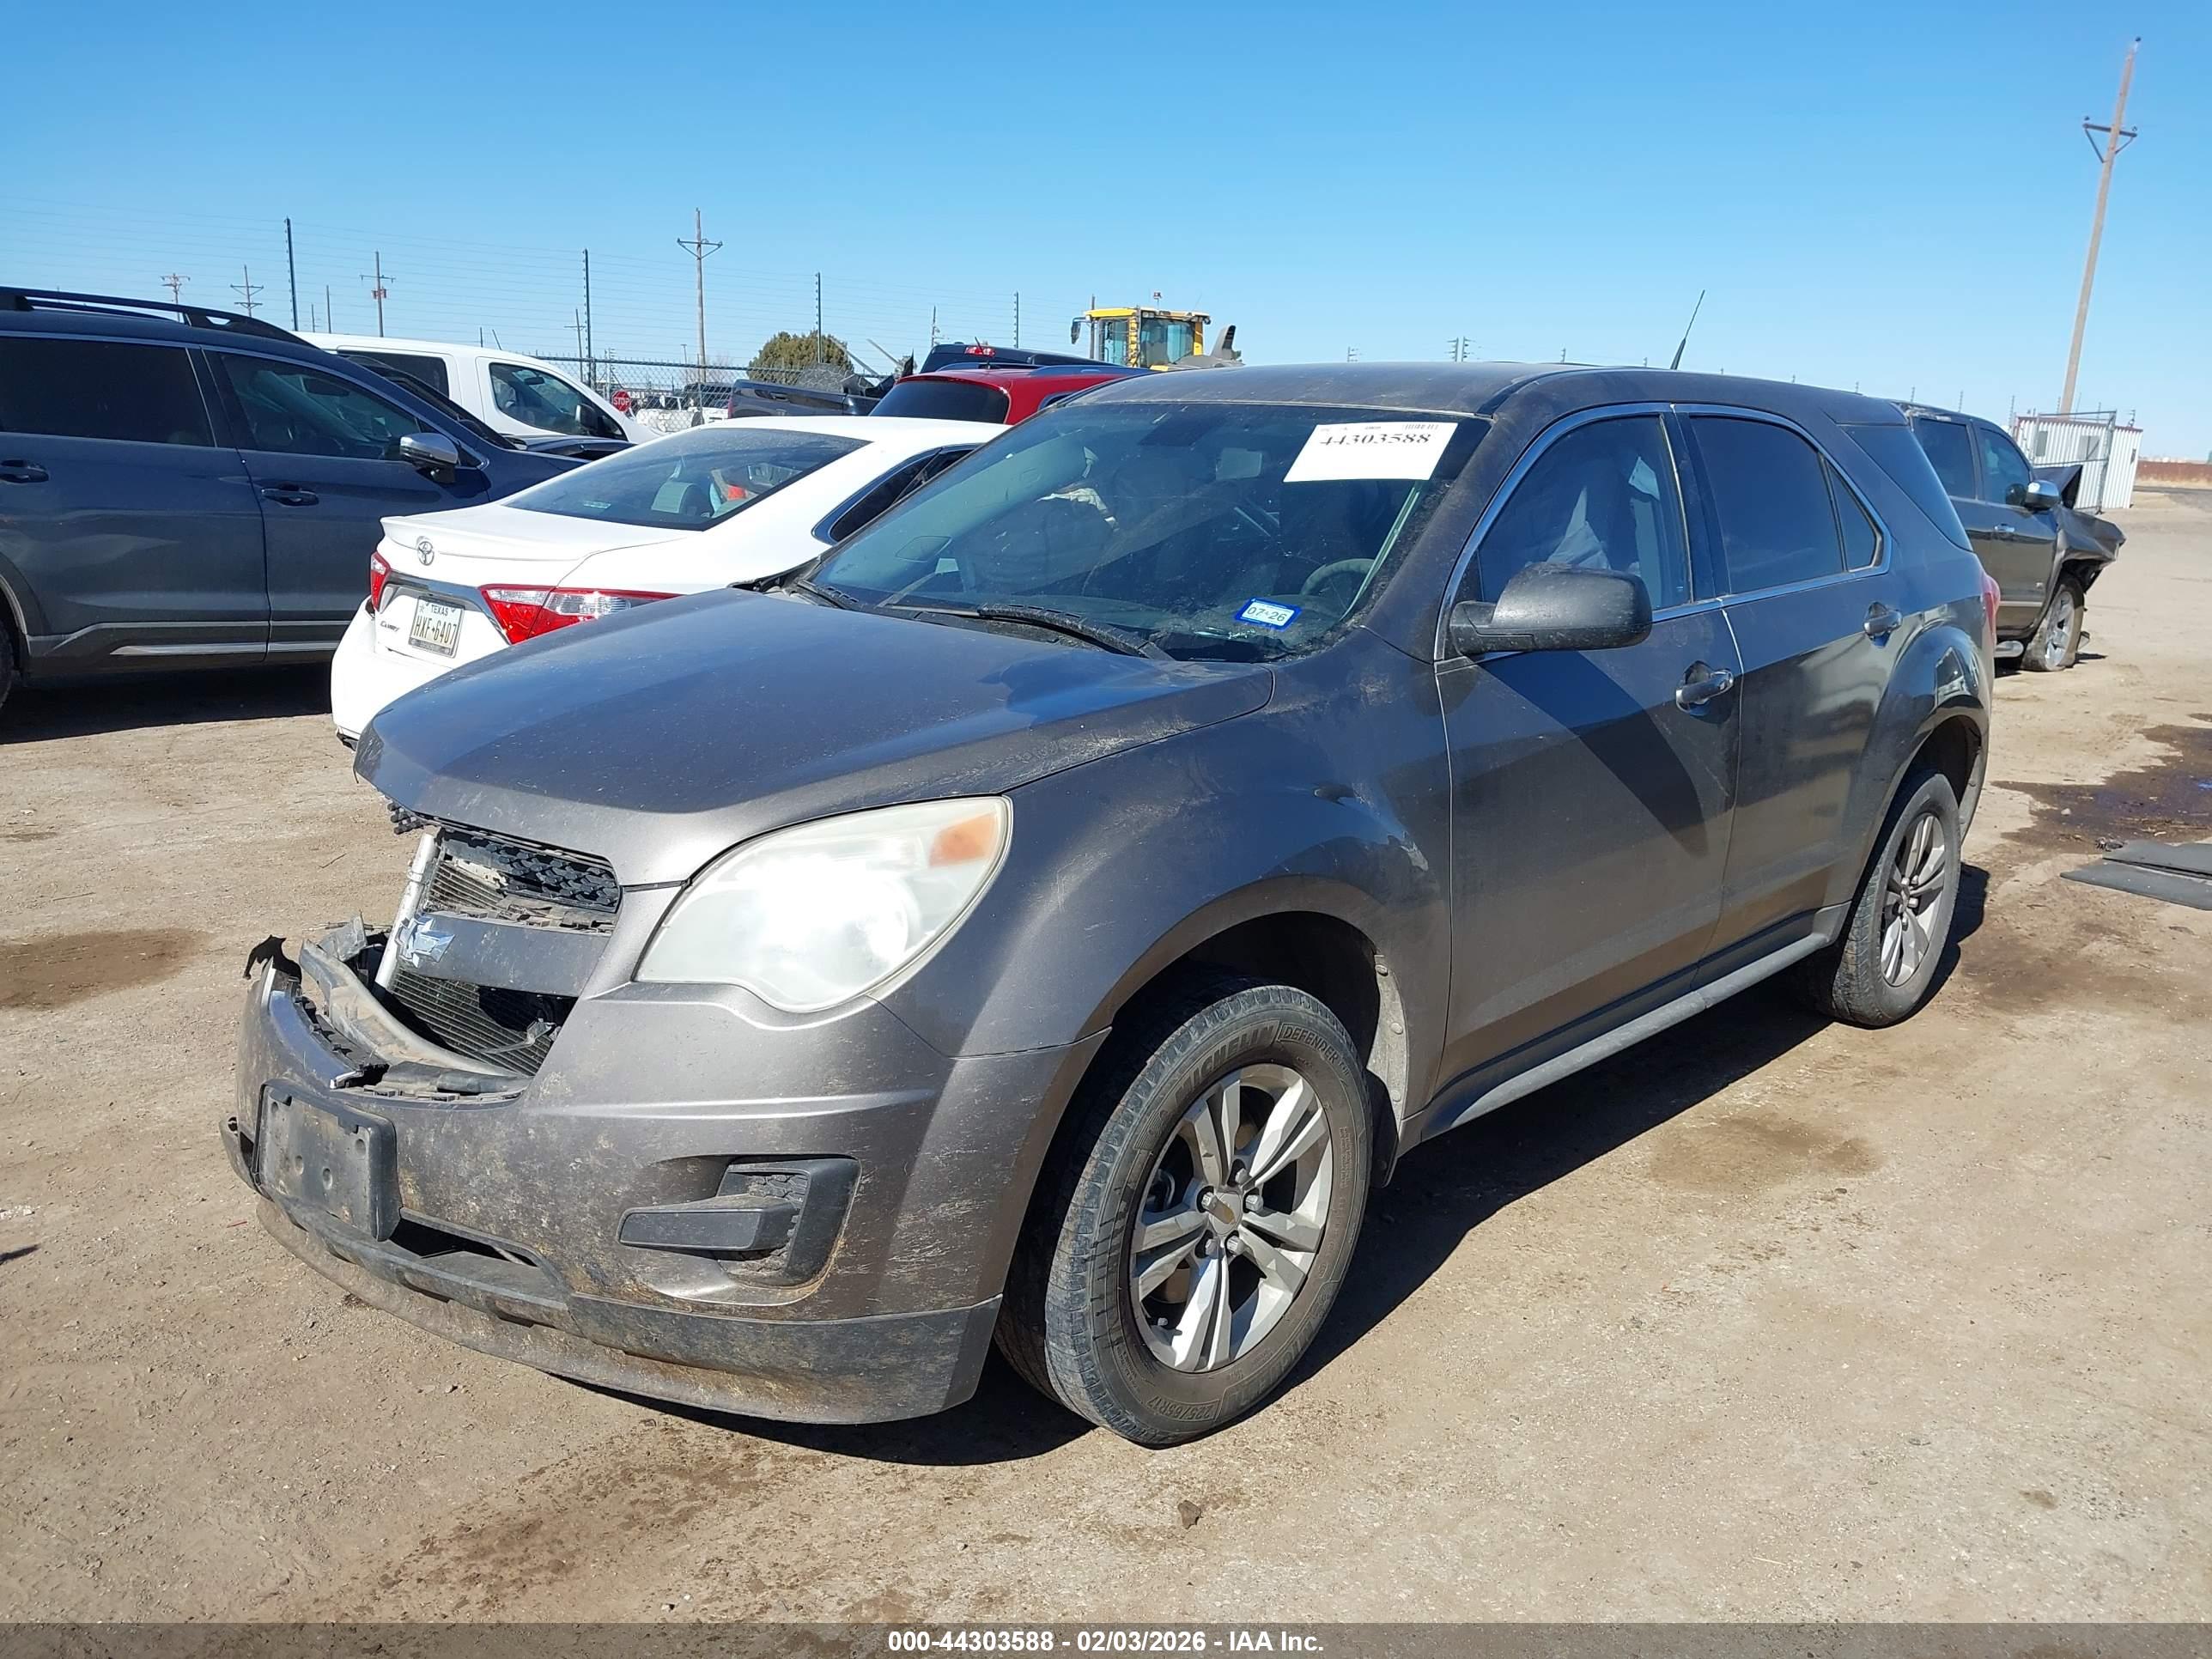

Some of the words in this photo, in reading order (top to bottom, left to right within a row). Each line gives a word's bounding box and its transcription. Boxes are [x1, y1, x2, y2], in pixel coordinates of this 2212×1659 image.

[1320, 433, 1431, 446] 44303588
[431, 604, 448, 617] TEXAS
[1282, 1026, 1340, 1064] DEFENDER
[1174, 1024, 1275, 1108] MICHELIN
[1147, 1395, 1212, 1420] 225/65R17
